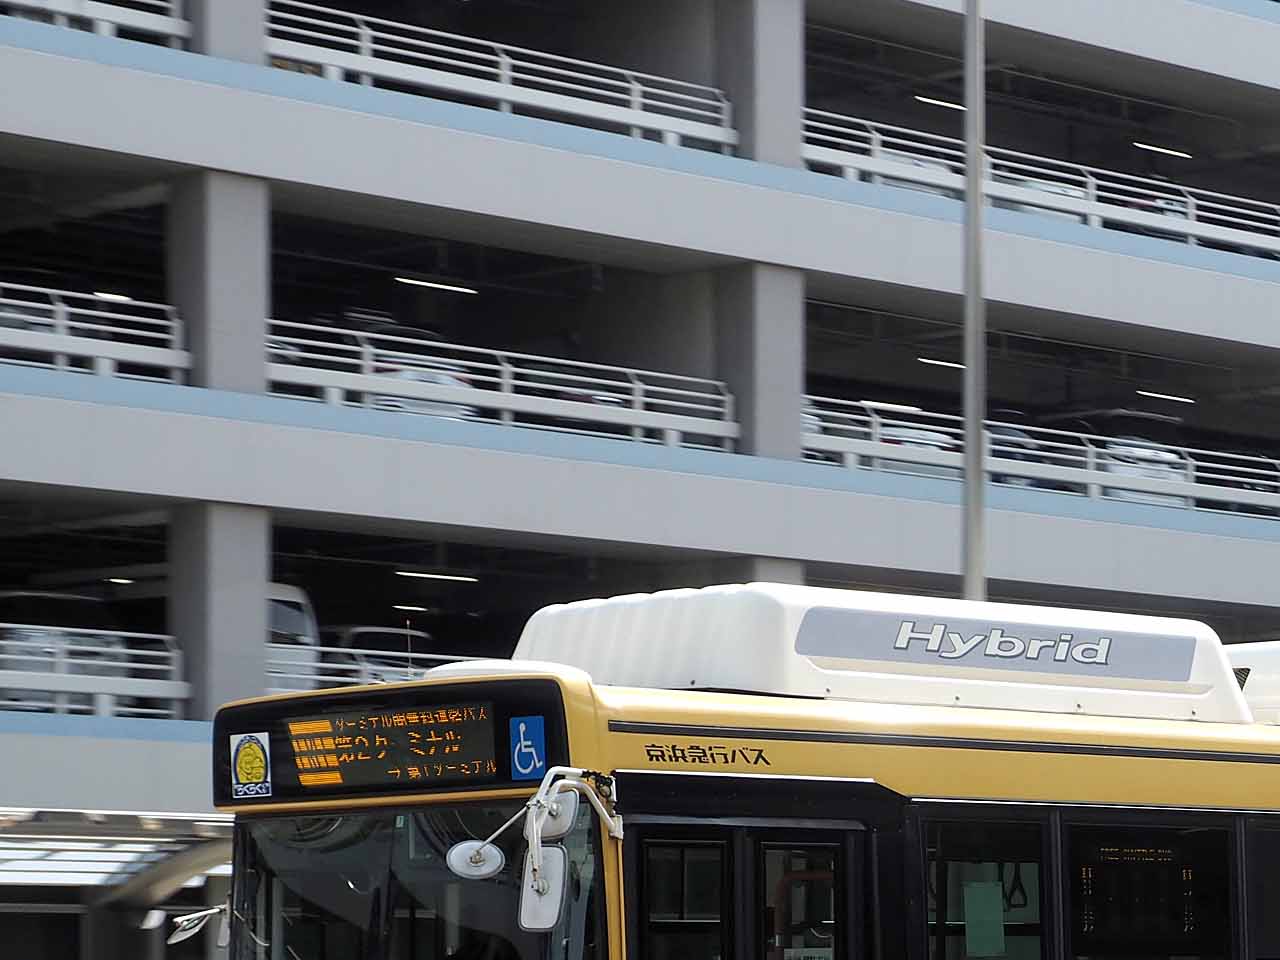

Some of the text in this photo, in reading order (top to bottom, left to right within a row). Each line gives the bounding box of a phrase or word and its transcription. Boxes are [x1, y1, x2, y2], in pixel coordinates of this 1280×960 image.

[893, 620, 1113, 666] Hybrid
[644, 743, 771, 766] 京浜急行バス
